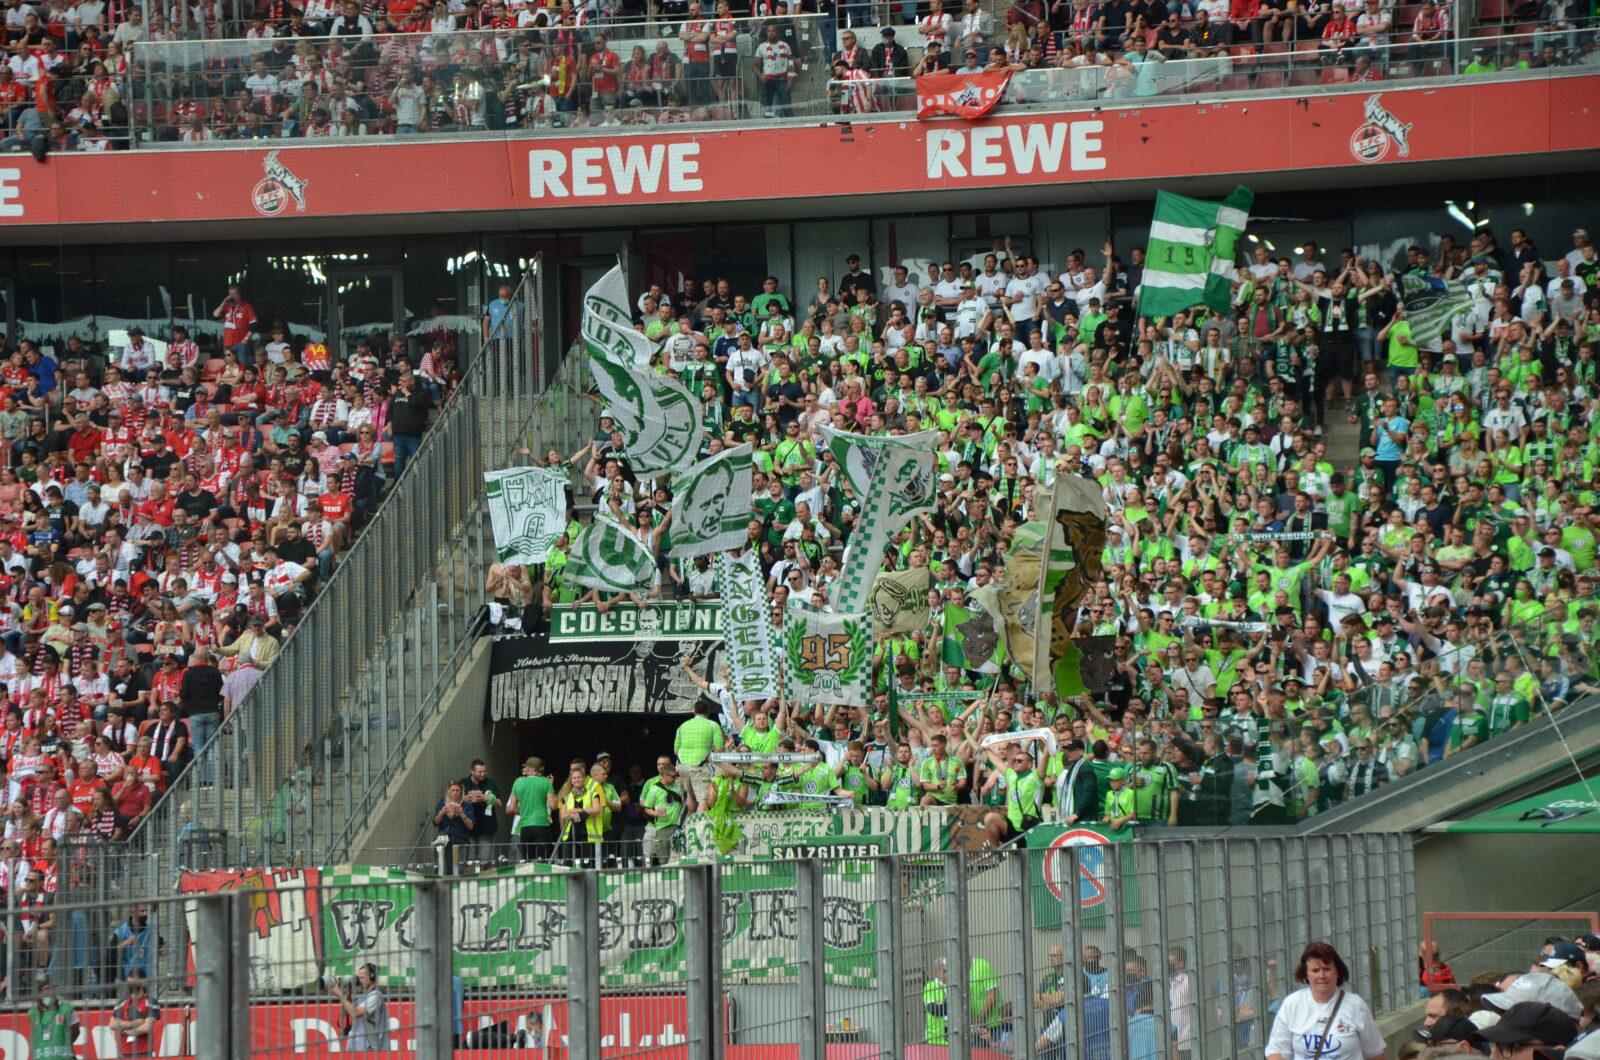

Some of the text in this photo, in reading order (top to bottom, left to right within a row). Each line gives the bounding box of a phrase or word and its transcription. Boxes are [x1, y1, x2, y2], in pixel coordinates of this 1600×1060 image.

[529, 143, 703, 198] REWE
[926, 120, 1106, 179] REWE
[310, 344, 327, 355] 14
[1252, 532, 1314, 541] WOLFSBURG
[727, 561, 770, 693] ANGELS
[800, 634, 852, 672] 95
[491, 664, 632, 722] UNVERGESSEN
[773, 844, 880, 860] SALZGITTER
